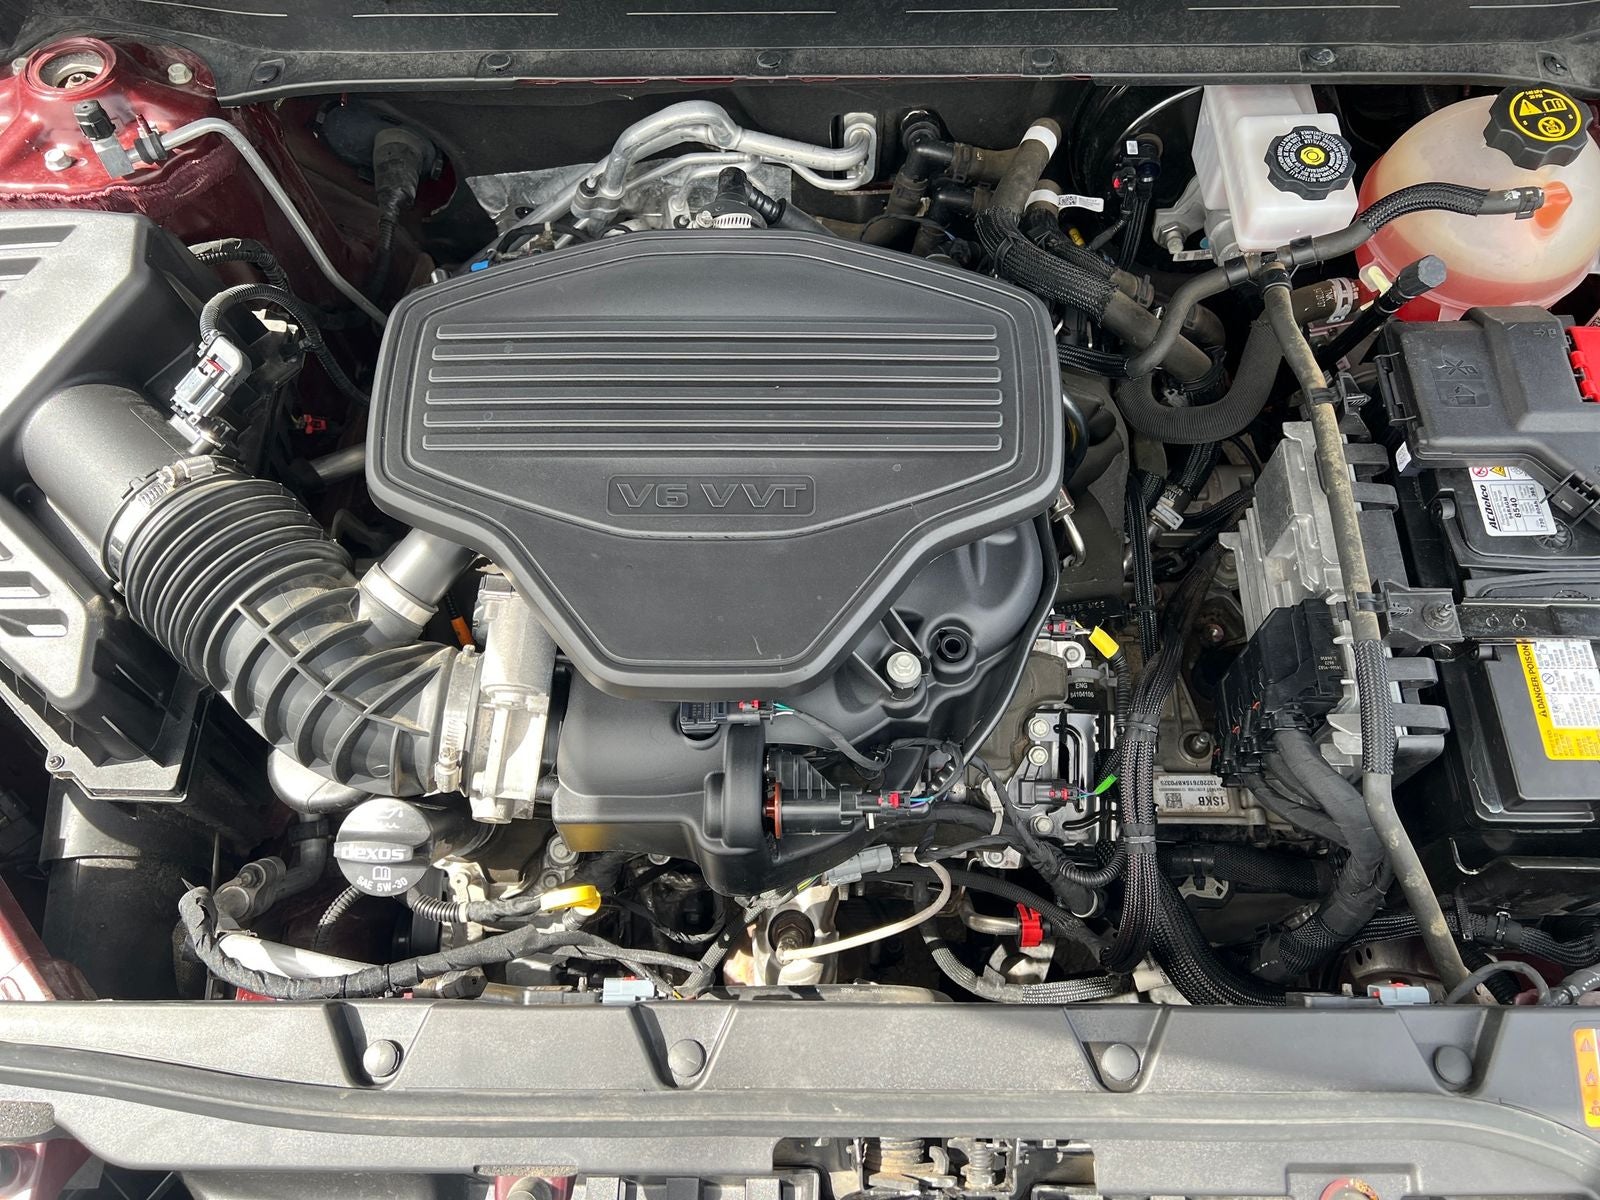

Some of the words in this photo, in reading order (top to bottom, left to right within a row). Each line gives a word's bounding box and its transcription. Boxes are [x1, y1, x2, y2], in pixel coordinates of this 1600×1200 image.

[616, 483, 688, 508] V6
[700, 483, 807, 508] VVT
[1480, 485, 1498, 529] ACDelco
[1510, 498, 1521, 518] 8540
[1198, 796, 1226, 806] 1SKB
[341, 844, 407, 860] dexos
[356, 876, 374, 890] SAE
[376, 877, 408, 892] 5W-30
